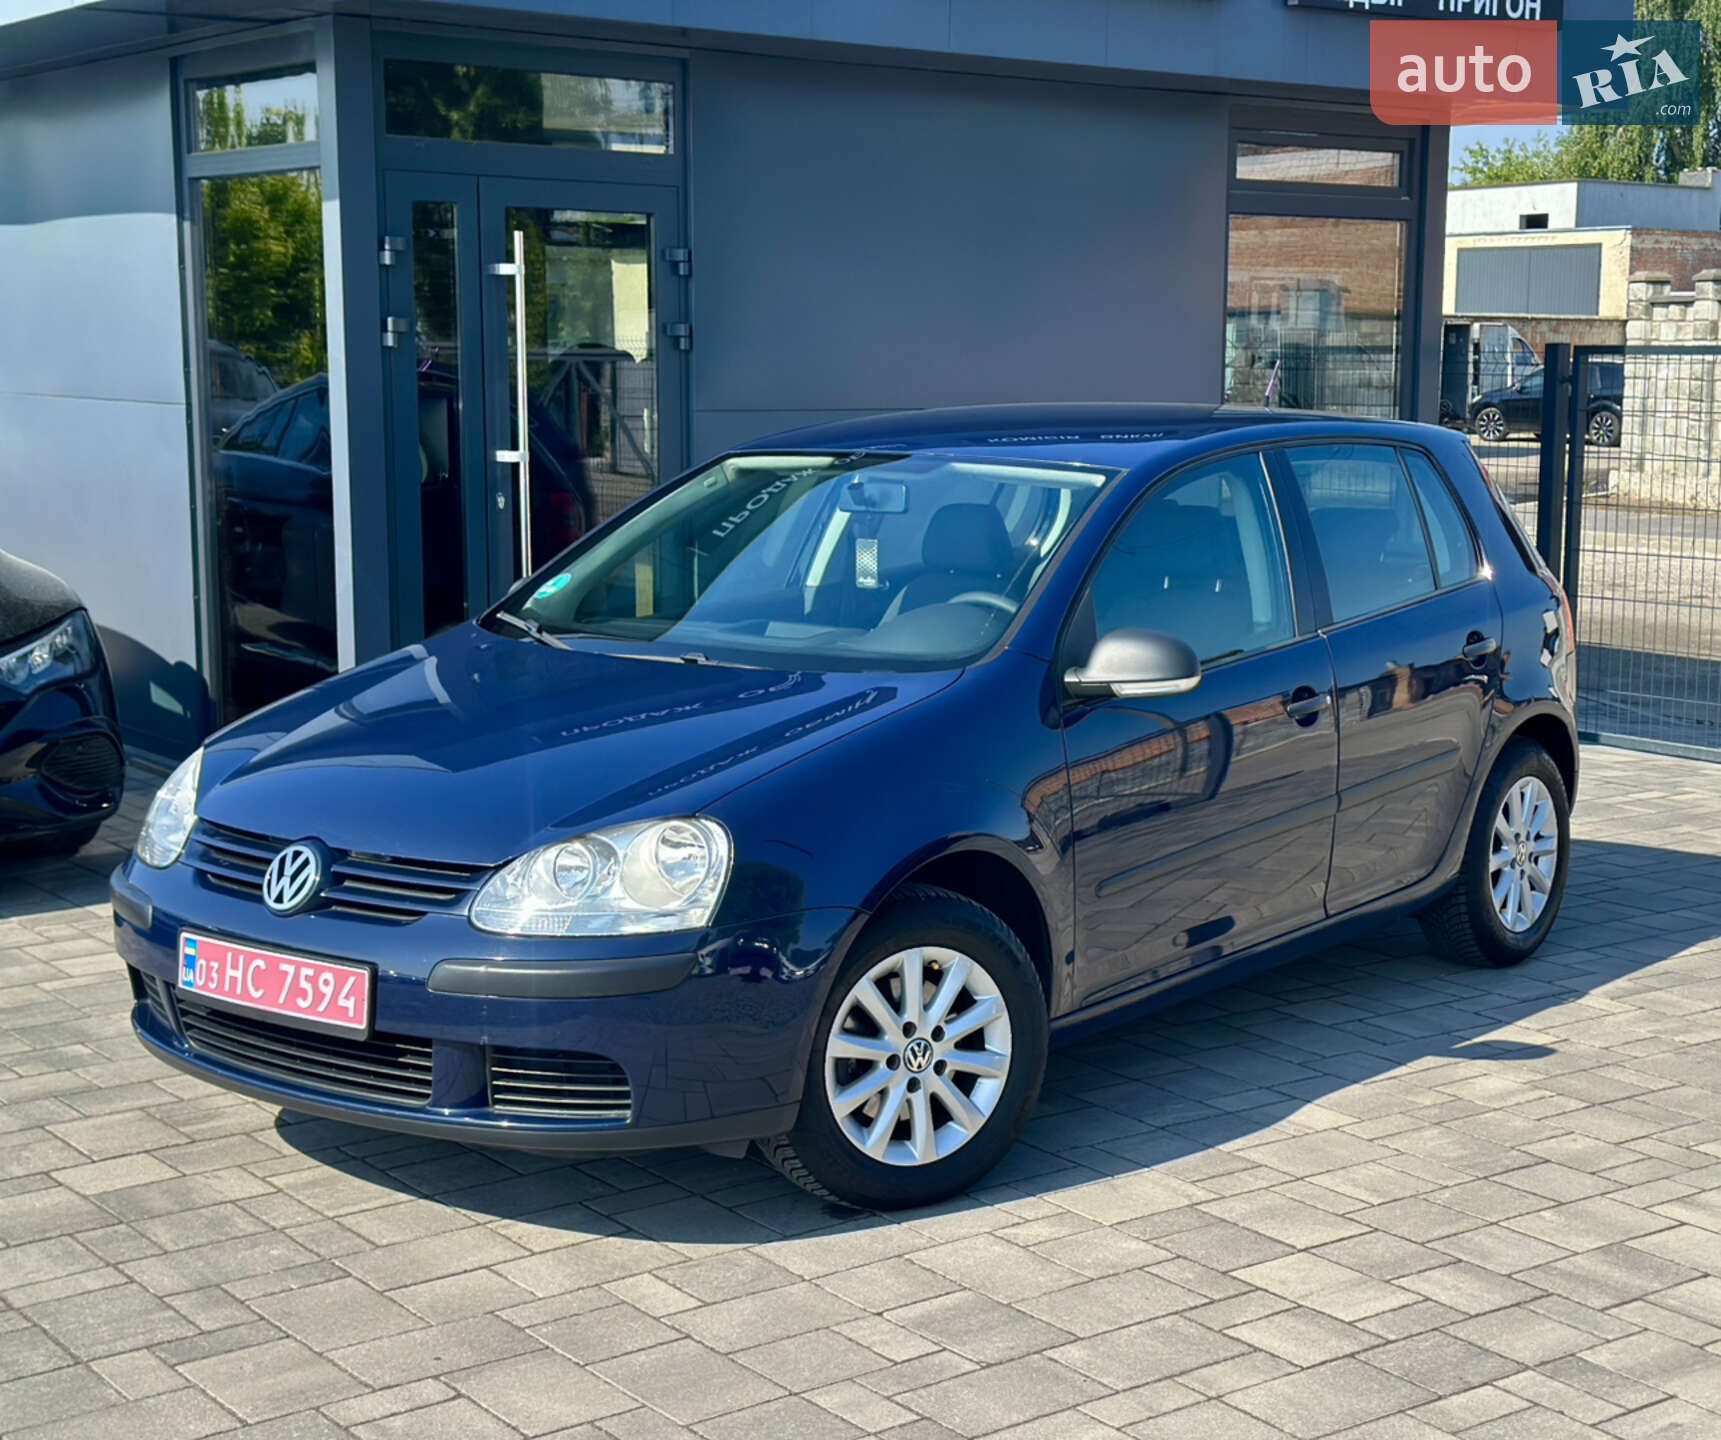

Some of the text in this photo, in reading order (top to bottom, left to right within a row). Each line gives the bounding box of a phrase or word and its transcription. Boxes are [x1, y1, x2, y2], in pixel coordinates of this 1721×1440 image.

[263, 845, 318, 910] VW
[183, 966, 195, 984] UA
[278, 963, 357, 1018] 7594
